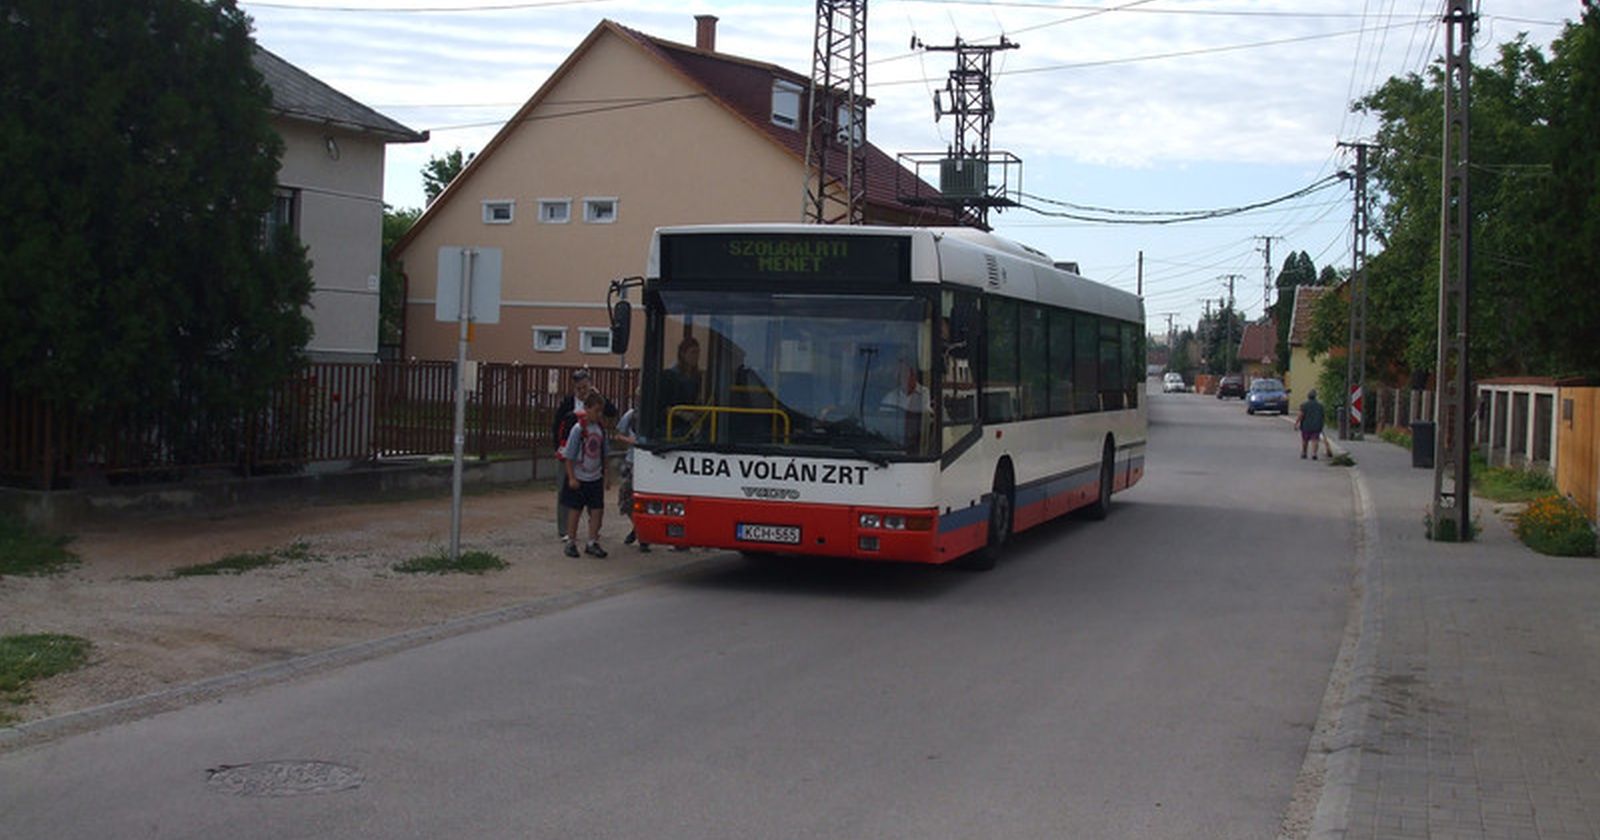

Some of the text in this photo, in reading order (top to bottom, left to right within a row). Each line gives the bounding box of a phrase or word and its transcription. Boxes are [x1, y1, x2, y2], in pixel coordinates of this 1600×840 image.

[758, 256, 823, 273] MENET
[673, 456, 868, 485] ALBA VOLÁN ZRT
